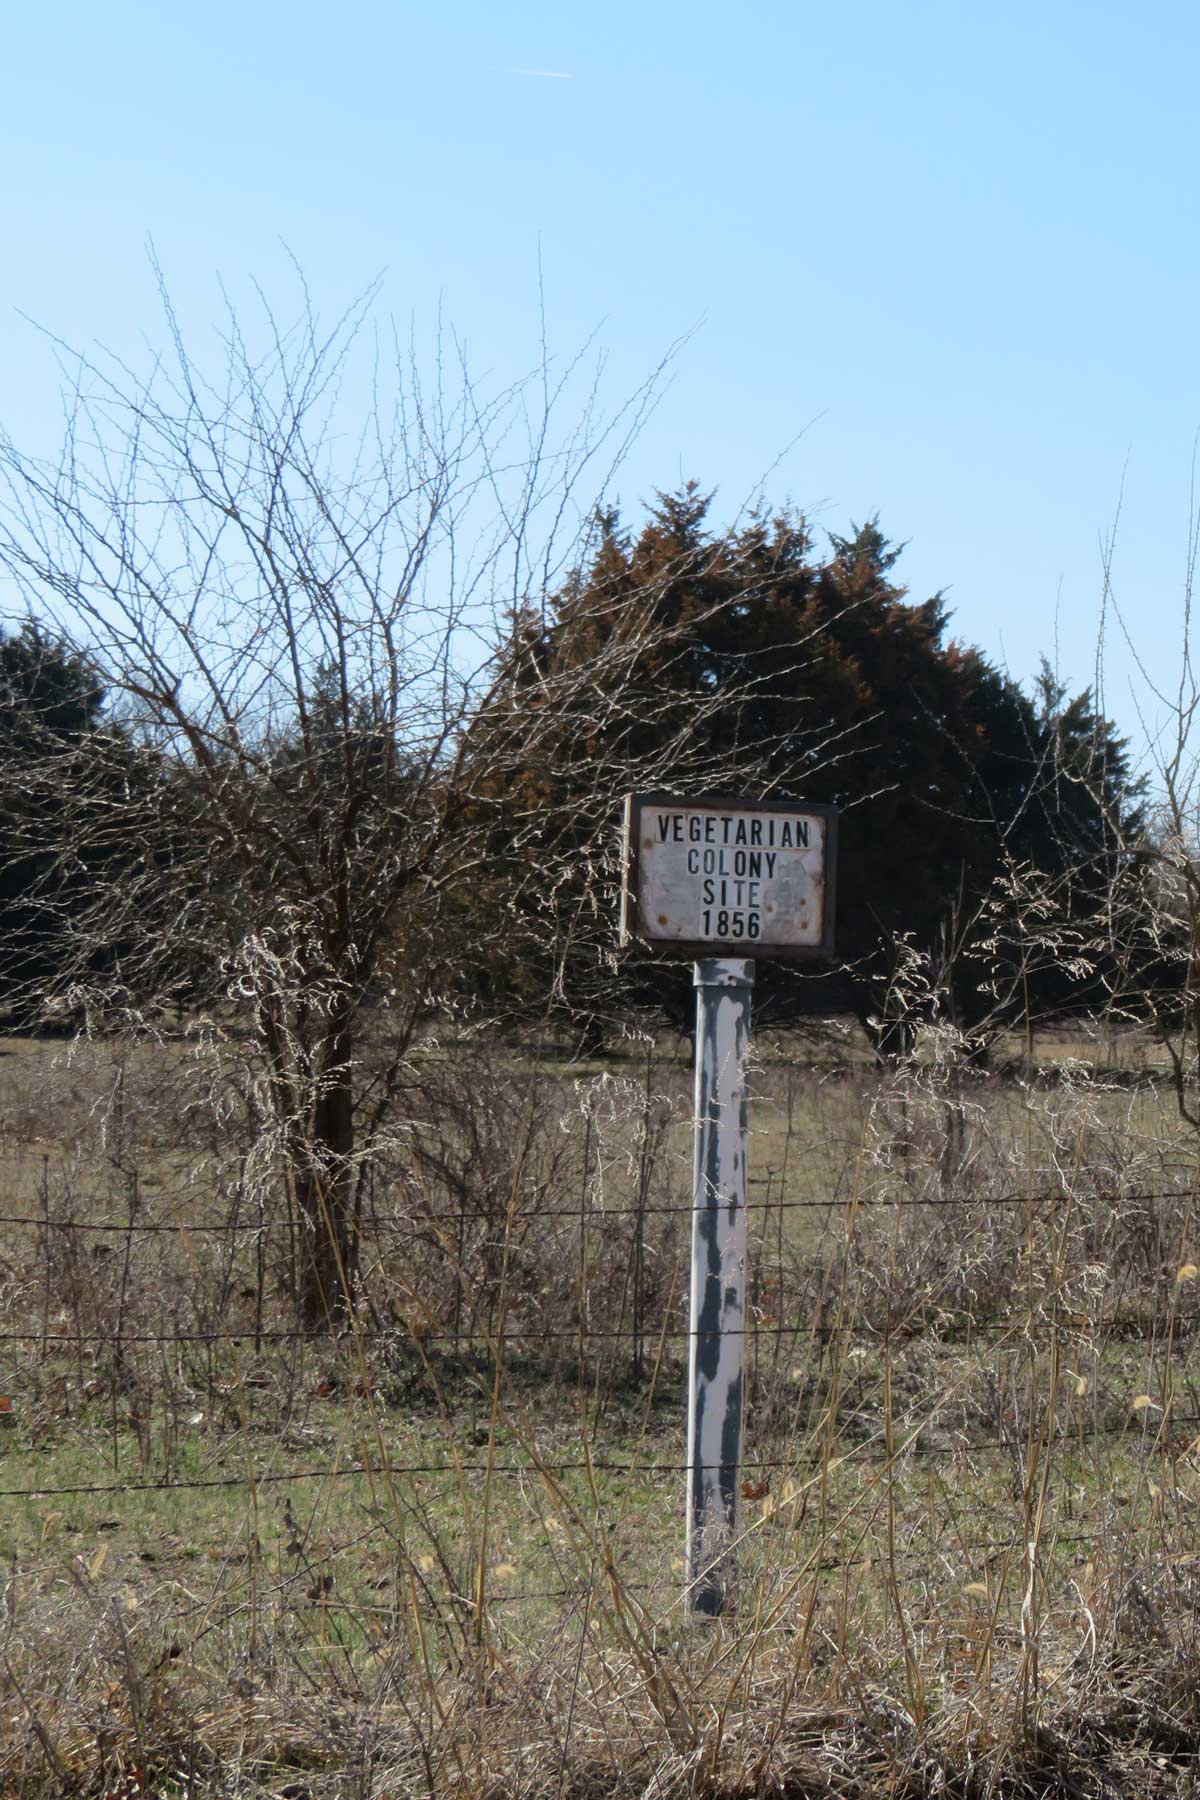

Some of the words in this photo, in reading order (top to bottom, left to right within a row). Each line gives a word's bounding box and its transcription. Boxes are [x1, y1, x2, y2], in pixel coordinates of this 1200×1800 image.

[658, 815, 809, 847] VEGETARIAN
[687, 848, 777, 878] COLONY
[702, 879, 760, 908] SITE
[702, 910, 760, 938] 1856
